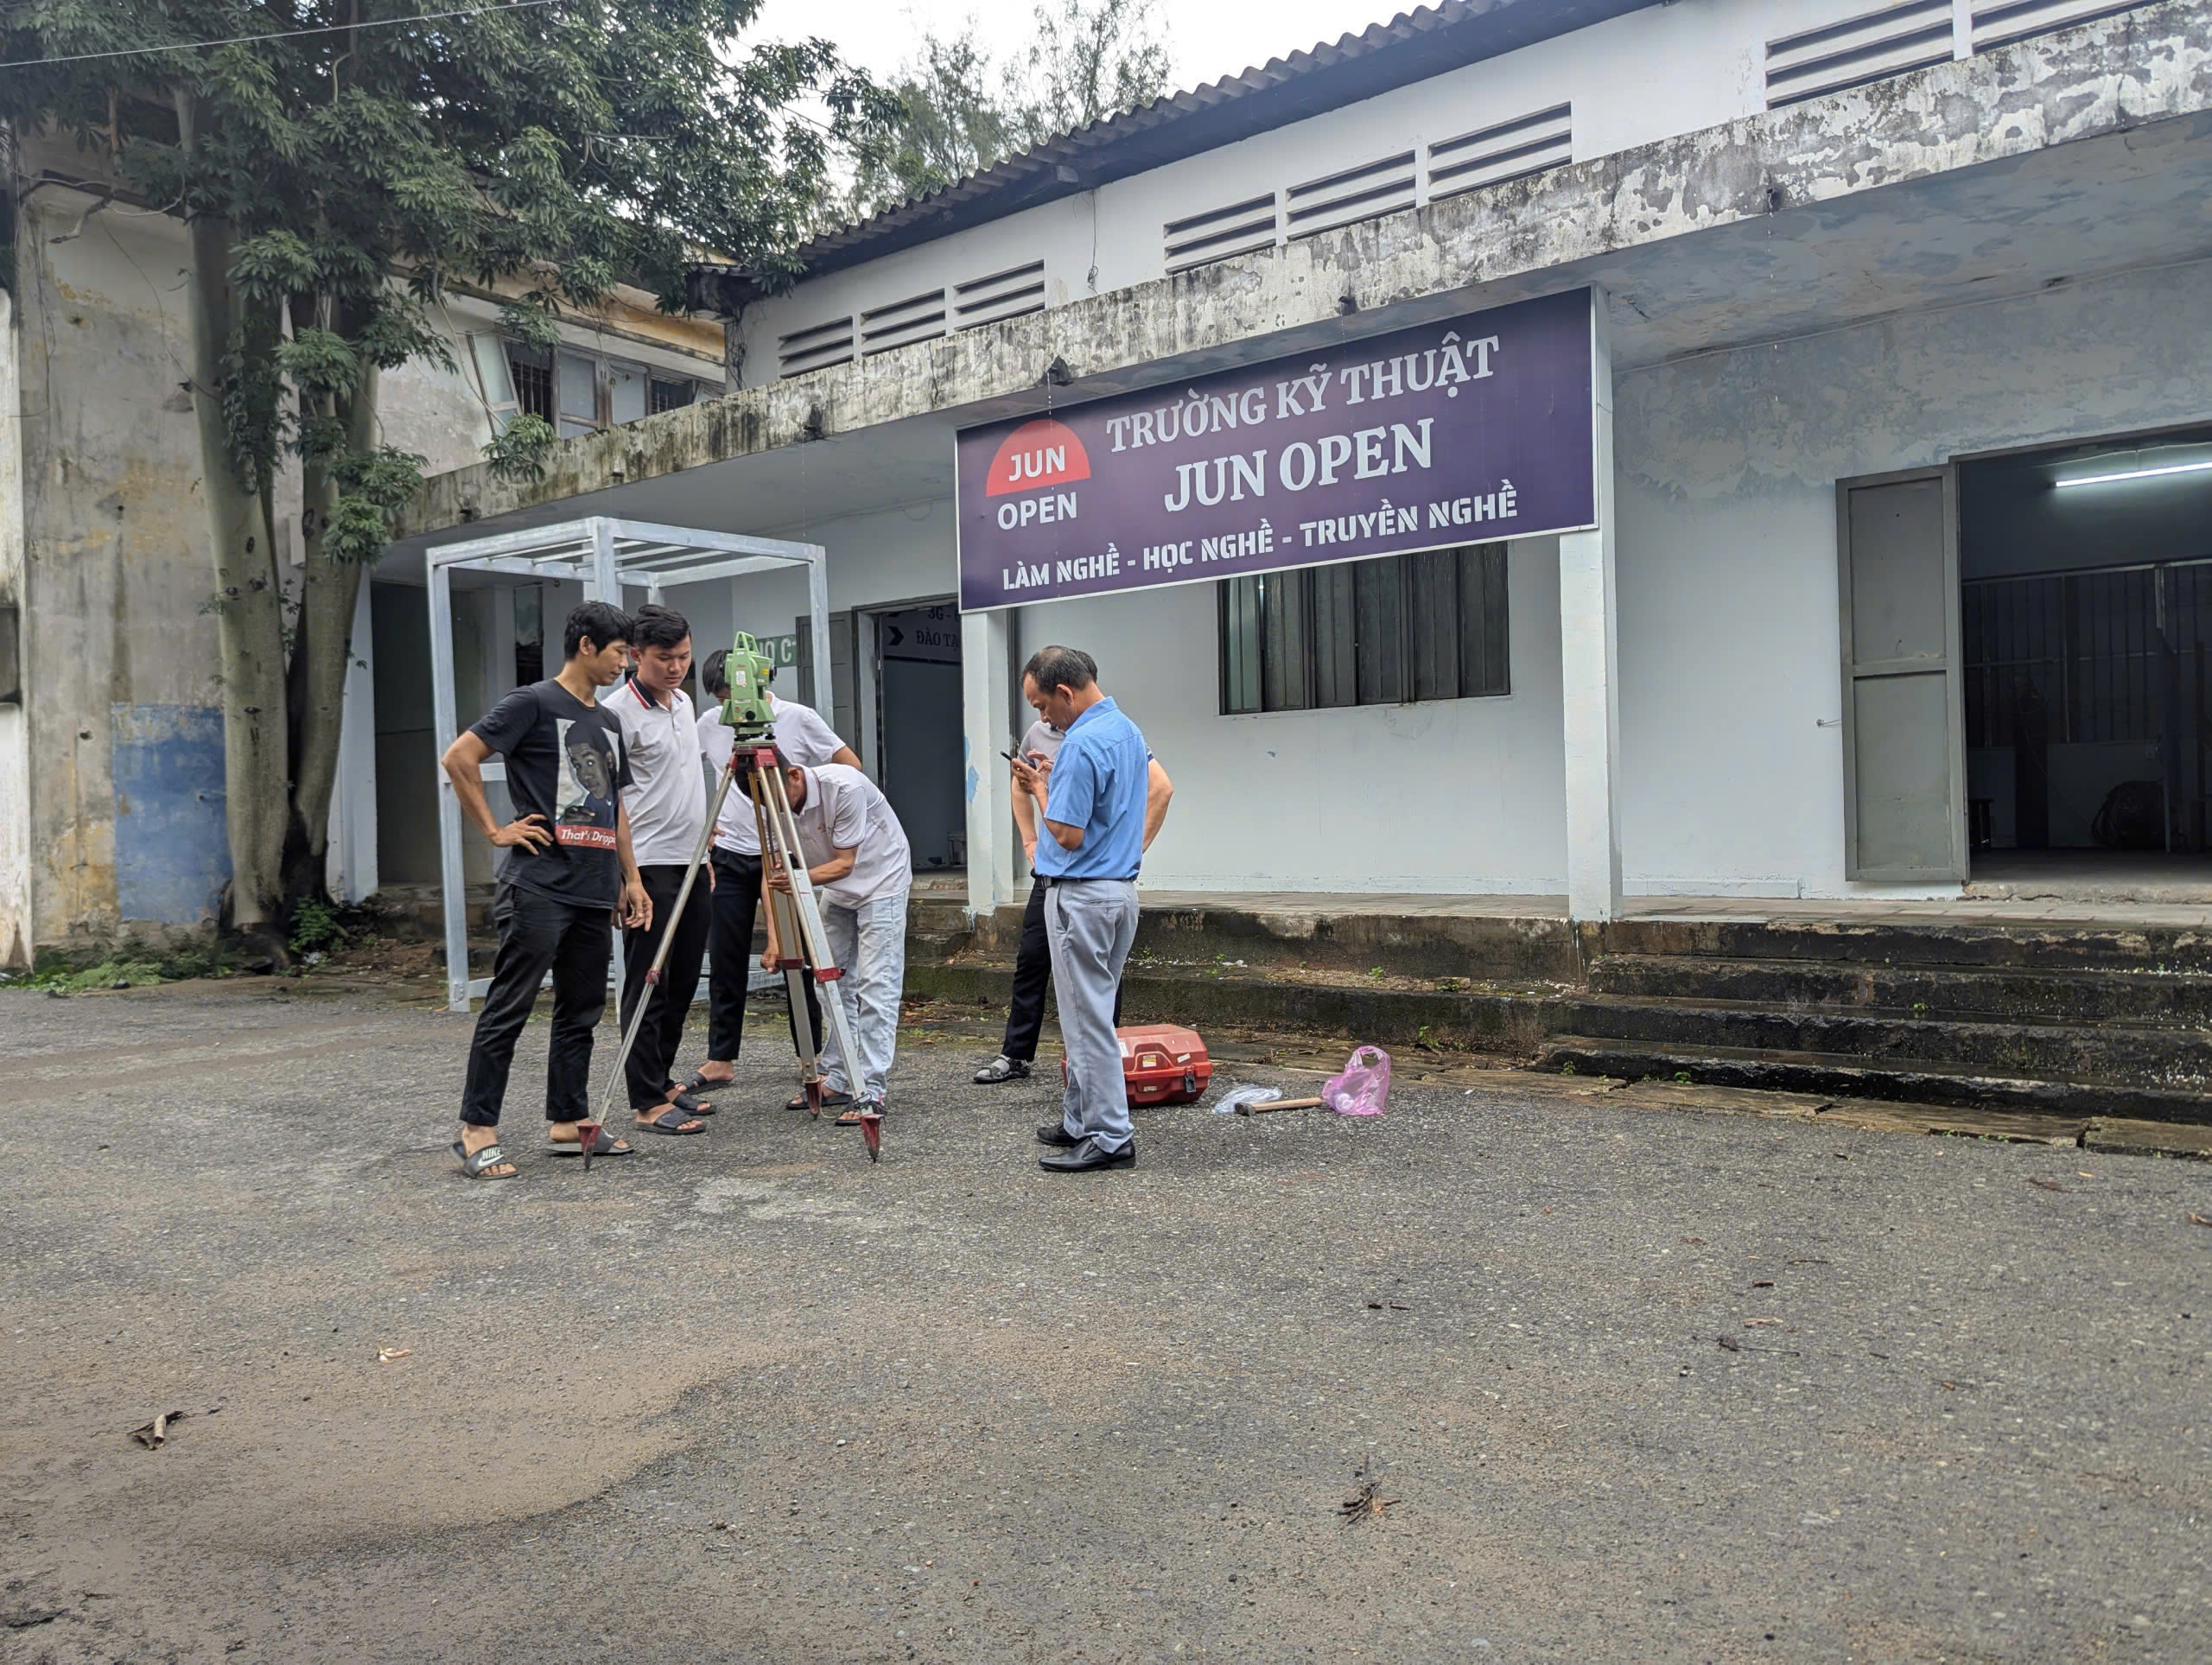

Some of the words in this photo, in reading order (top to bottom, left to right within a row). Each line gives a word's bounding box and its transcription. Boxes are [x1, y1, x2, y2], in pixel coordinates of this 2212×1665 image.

[1106, 388, 1267, 453] TRƯỜNG
[1276, 363, 1332, 419] KỸ
[1341, 331, 1499, 405] THUẬT
[1008, 445, 1065, 481] JUN
[1165, 449, 1268, 512] JUN
[1280, 417, 1434, 491] OPEN
[997, 492, 1077, 531] OPEN
[1003, 562, 1050, 590] LÀM
[1057, 543, 1120, 582] NGHỀ
[1143, 541, 1193, 573] HỌC
[1201, 518, 1274, 562] NGHỀ
[1300, 498, 1418, 547] TRUYỀN
[1428, 479, 1517, 529] NGHỀ
[916, 626, 941, 646] ĐÀO
[562, 829, 590, 841] That's
[482, 1146, 501, 1160] NIKE
